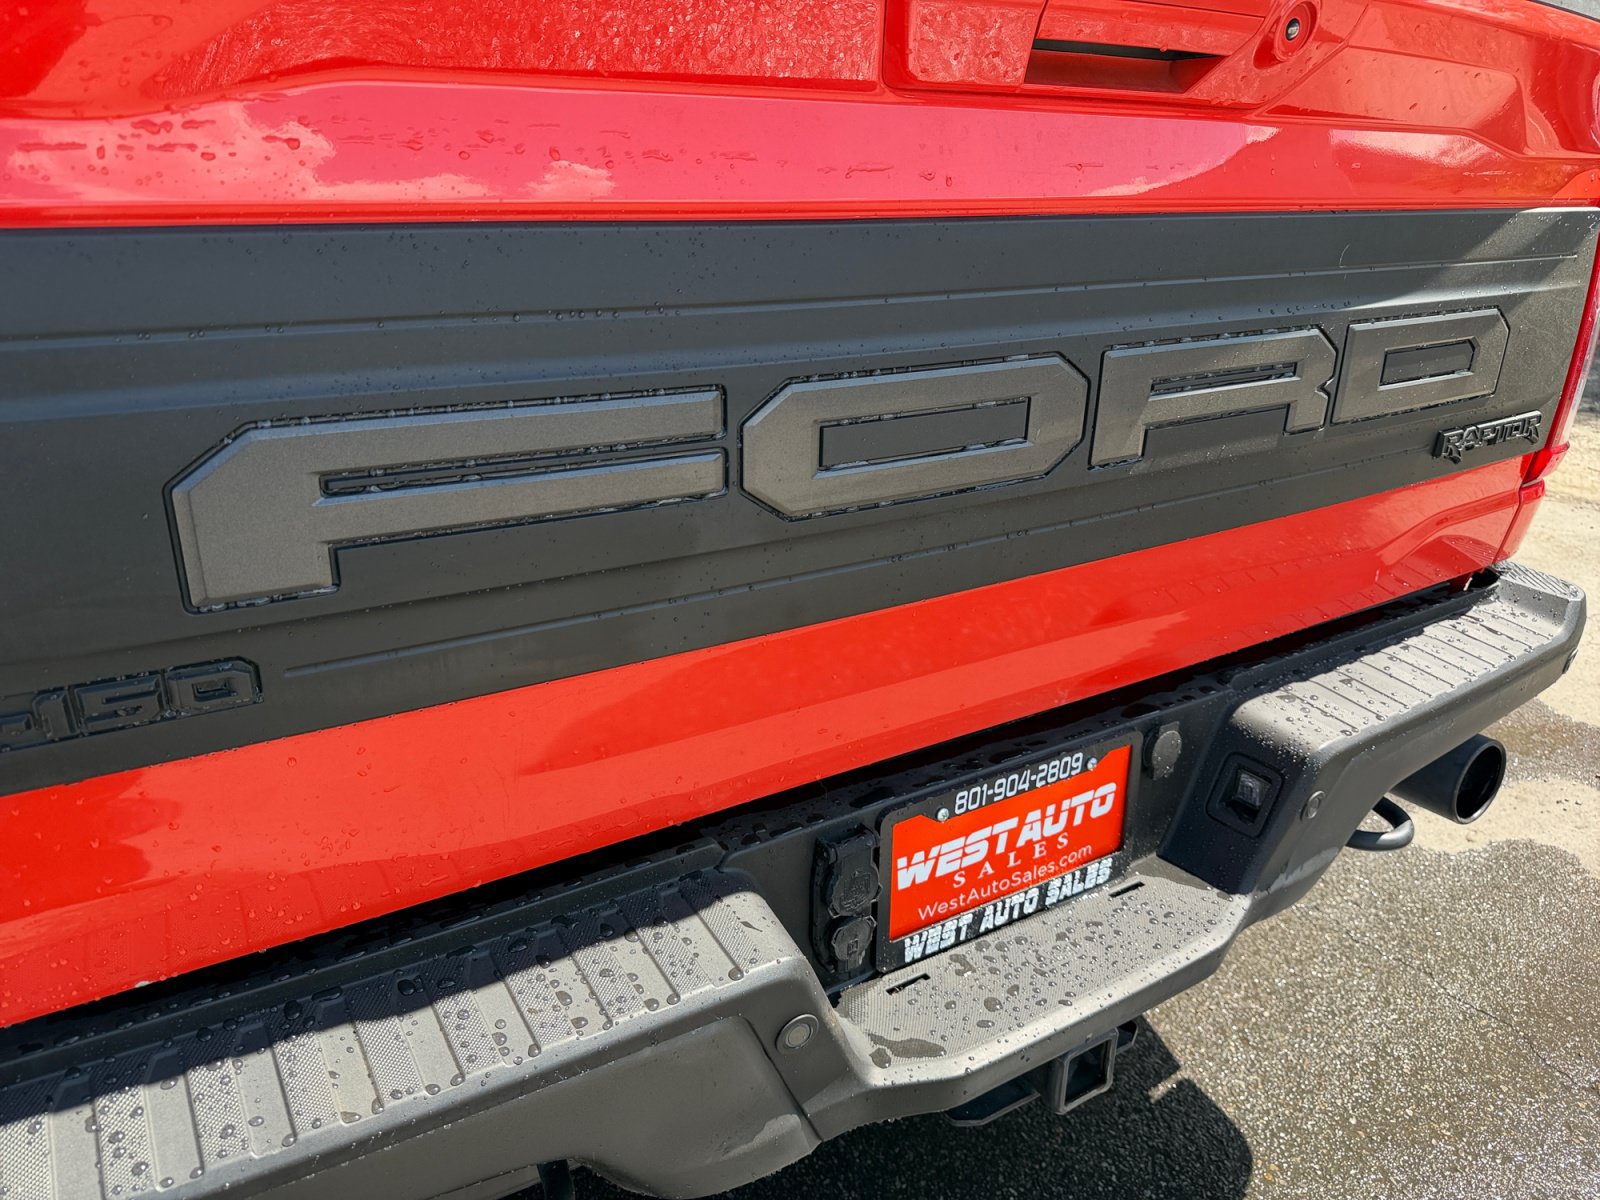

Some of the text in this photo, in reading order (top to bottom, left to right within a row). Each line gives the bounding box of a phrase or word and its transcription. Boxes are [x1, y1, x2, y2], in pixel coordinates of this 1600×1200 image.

[168, 306, 1510, 612] FORD
[1438, 410, 1542, 464] RAPTOR
[954, 752, 1083, 815] 801-904-2809
[896, 782, 1117, 891] WEST AUTO
[952, 832, 1069, 889] SALES
[904, 857, 1113, 963] WEST AUTO SALES
[917, 844, 1093, 921] WestAutoSales.com
